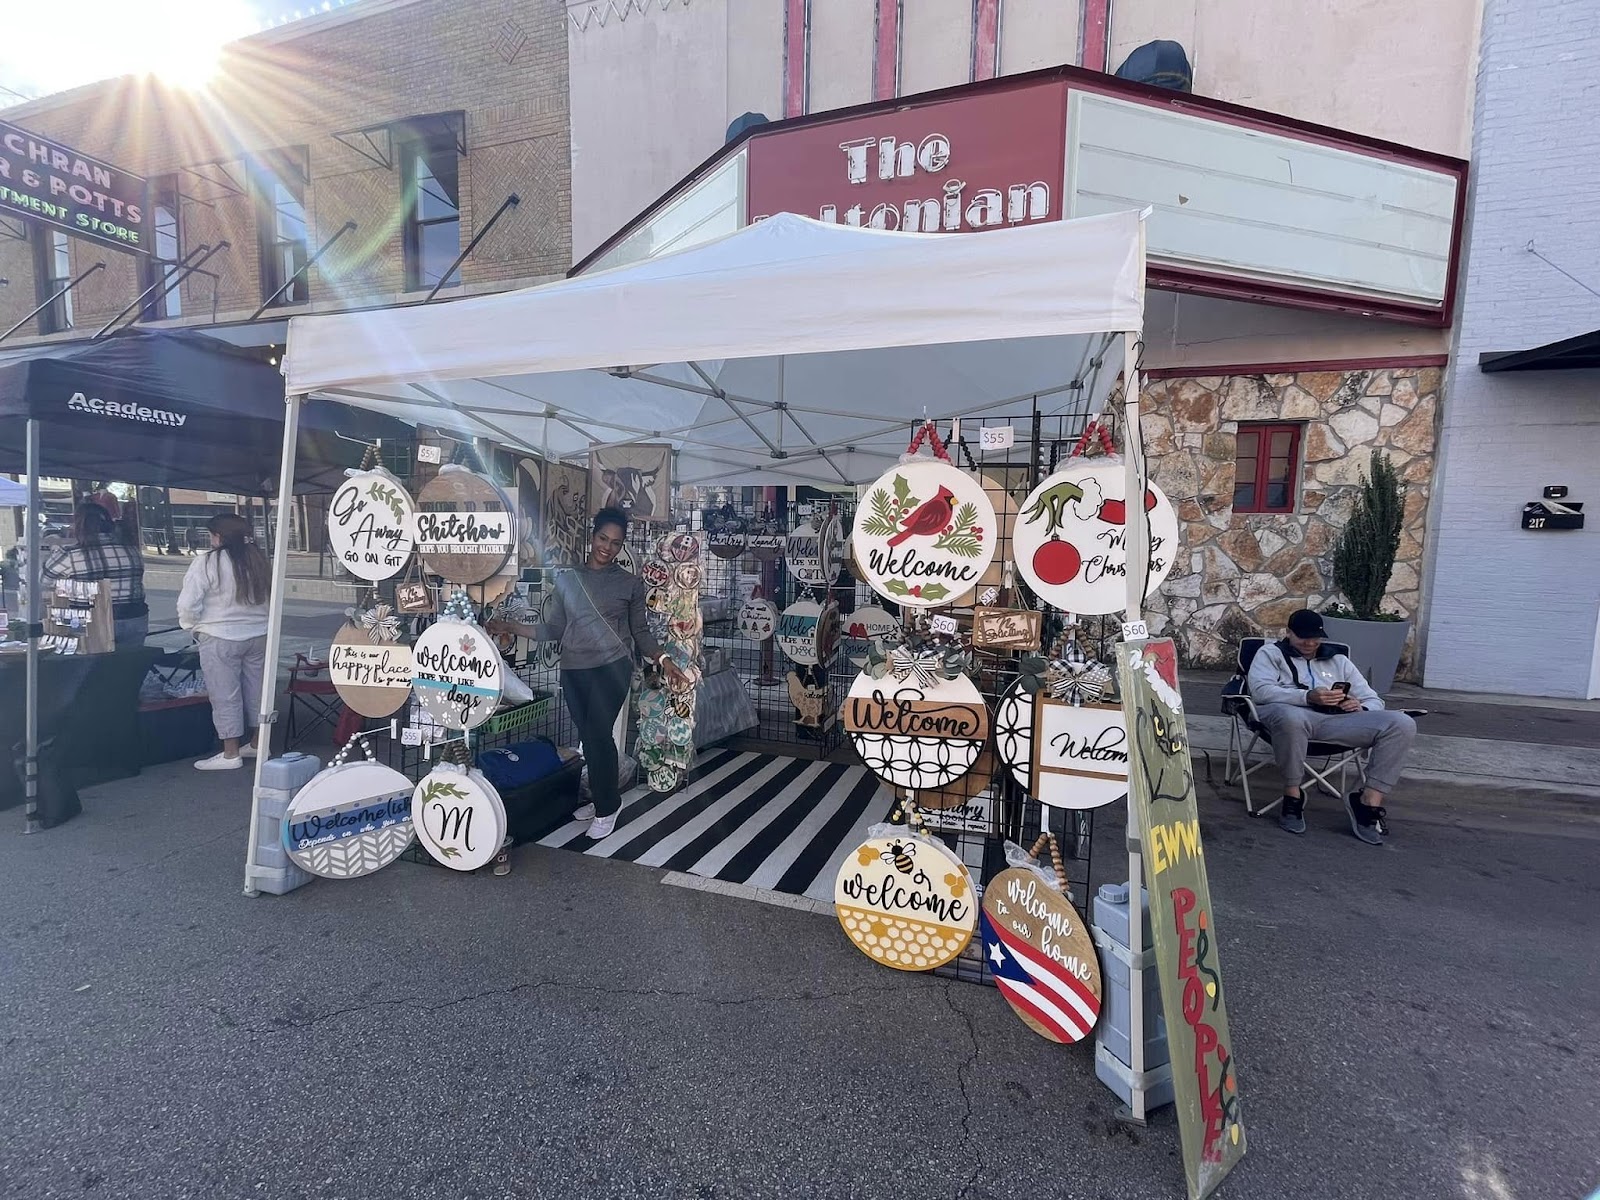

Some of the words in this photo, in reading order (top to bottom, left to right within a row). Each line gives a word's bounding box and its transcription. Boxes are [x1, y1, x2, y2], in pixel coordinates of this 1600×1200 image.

[839, 133, 951, 184] The
[22, 169, 41, 188] &
[50, 175, 142, 223] POTTS
[76, 213, 140, 243] STORE
[67, 392, 187, 426] Academy
[984, 432, 1005, 444] $55
[333, 486, 368, 526] Go
[349, 513, 409, 551] Away
[417, 513, 505, 543] Shitshow
[1528, 518, 1546, 529] 217
[344, 550, 359, 563] GO
[364, 552, 379, 565] ON
[384, 554, 403, 567] GIT
[419, 544, 435, 554] HOPE
[436, 544, 449, 554] YOU
[450, 544, 478, 554] BROUGHT
[479, 544, 506, 554] ALCOHOL
[869, 546, 978, 581] Welcome
[981, 588, 997, 604] $15
[867, 623, 890, 632] HOME
[933, 618, 955, 632] $60
[1123, 624, 1146, 637] $60
[332, 646, 373, 684] happy
[374, 650, 412, 683] place
[417, 644, 497, 679] welcome
[418, 671, 436, 681] HOPE
[439, 675, 453, 684] YOU
[458, 678, 475, 688] LIKE
[447, 684, 482, 725] dogs
[853, 688, 980, 737] Welcome
[1050, 726, 1128, 764] Welcom
[298, 833, 337, 850] Depends
[342, 830, 352, 838] on
[360, 823, 376, 834] who
[433, 803, 475, 851] M
[843, 874, 969, 922] welcome
[996, 898, 1009, 915] to
[1007, 878, 1073, 938] welcome
[1012, 920, 1032, 940] our
[1041, 930, 1092, 982] home
[1171, 887, 1223, 1163] PEOPLE
